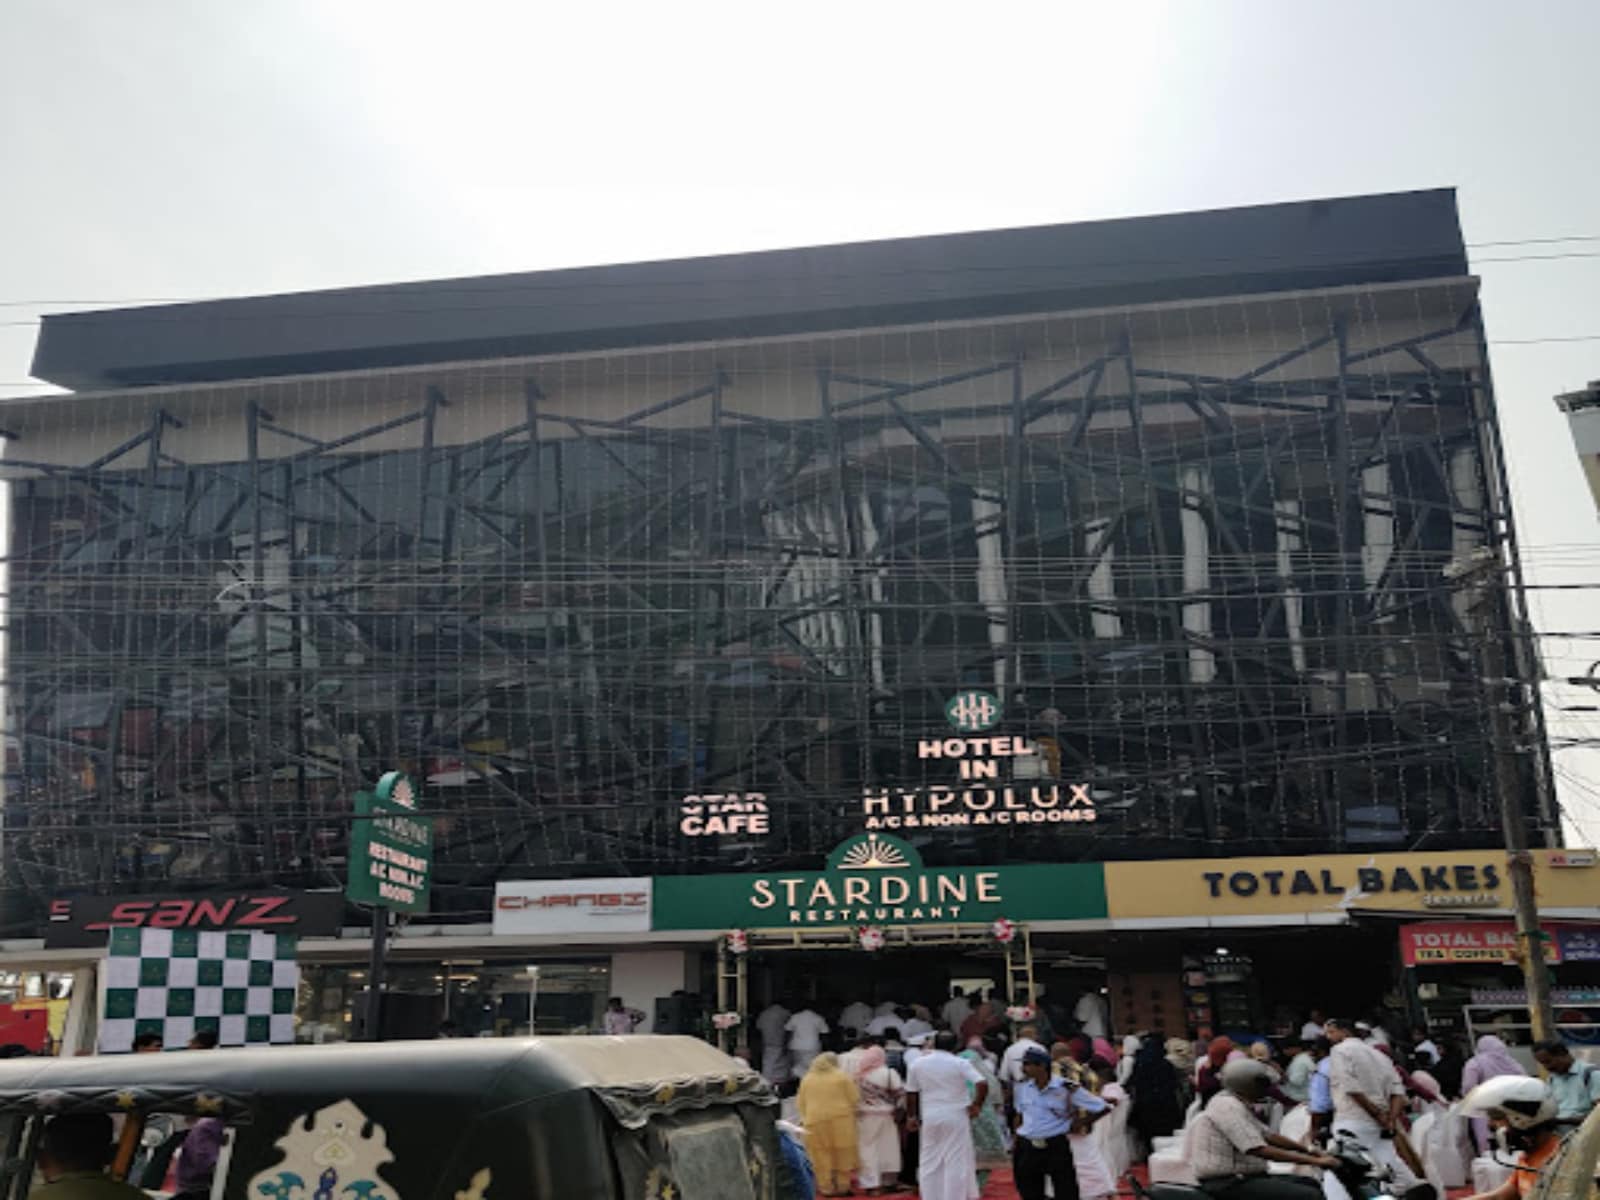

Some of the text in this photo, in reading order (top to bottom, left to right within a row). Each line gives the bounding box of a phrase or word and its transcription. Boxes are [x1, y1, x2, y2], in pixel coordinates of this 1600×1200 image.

[918, 736, 1034, 758] HOTEL
[959, 760, 998, 779] IN
[681, 792, 769, 814] STAR
[863, 783, 1094, 814] HYPOLUX
[680, 814, 769, 836] CAFE
[865, 809, 1097, 829] A/C & NON A/C ROOMS
[750, 872, 1002, 908] STARDINE
[1203, 865, 1501, 897] TOTAL BAKES
[789, 906, 962, 922] RESTAURANT
[1411, 932, 1482, 947] TOTAL
